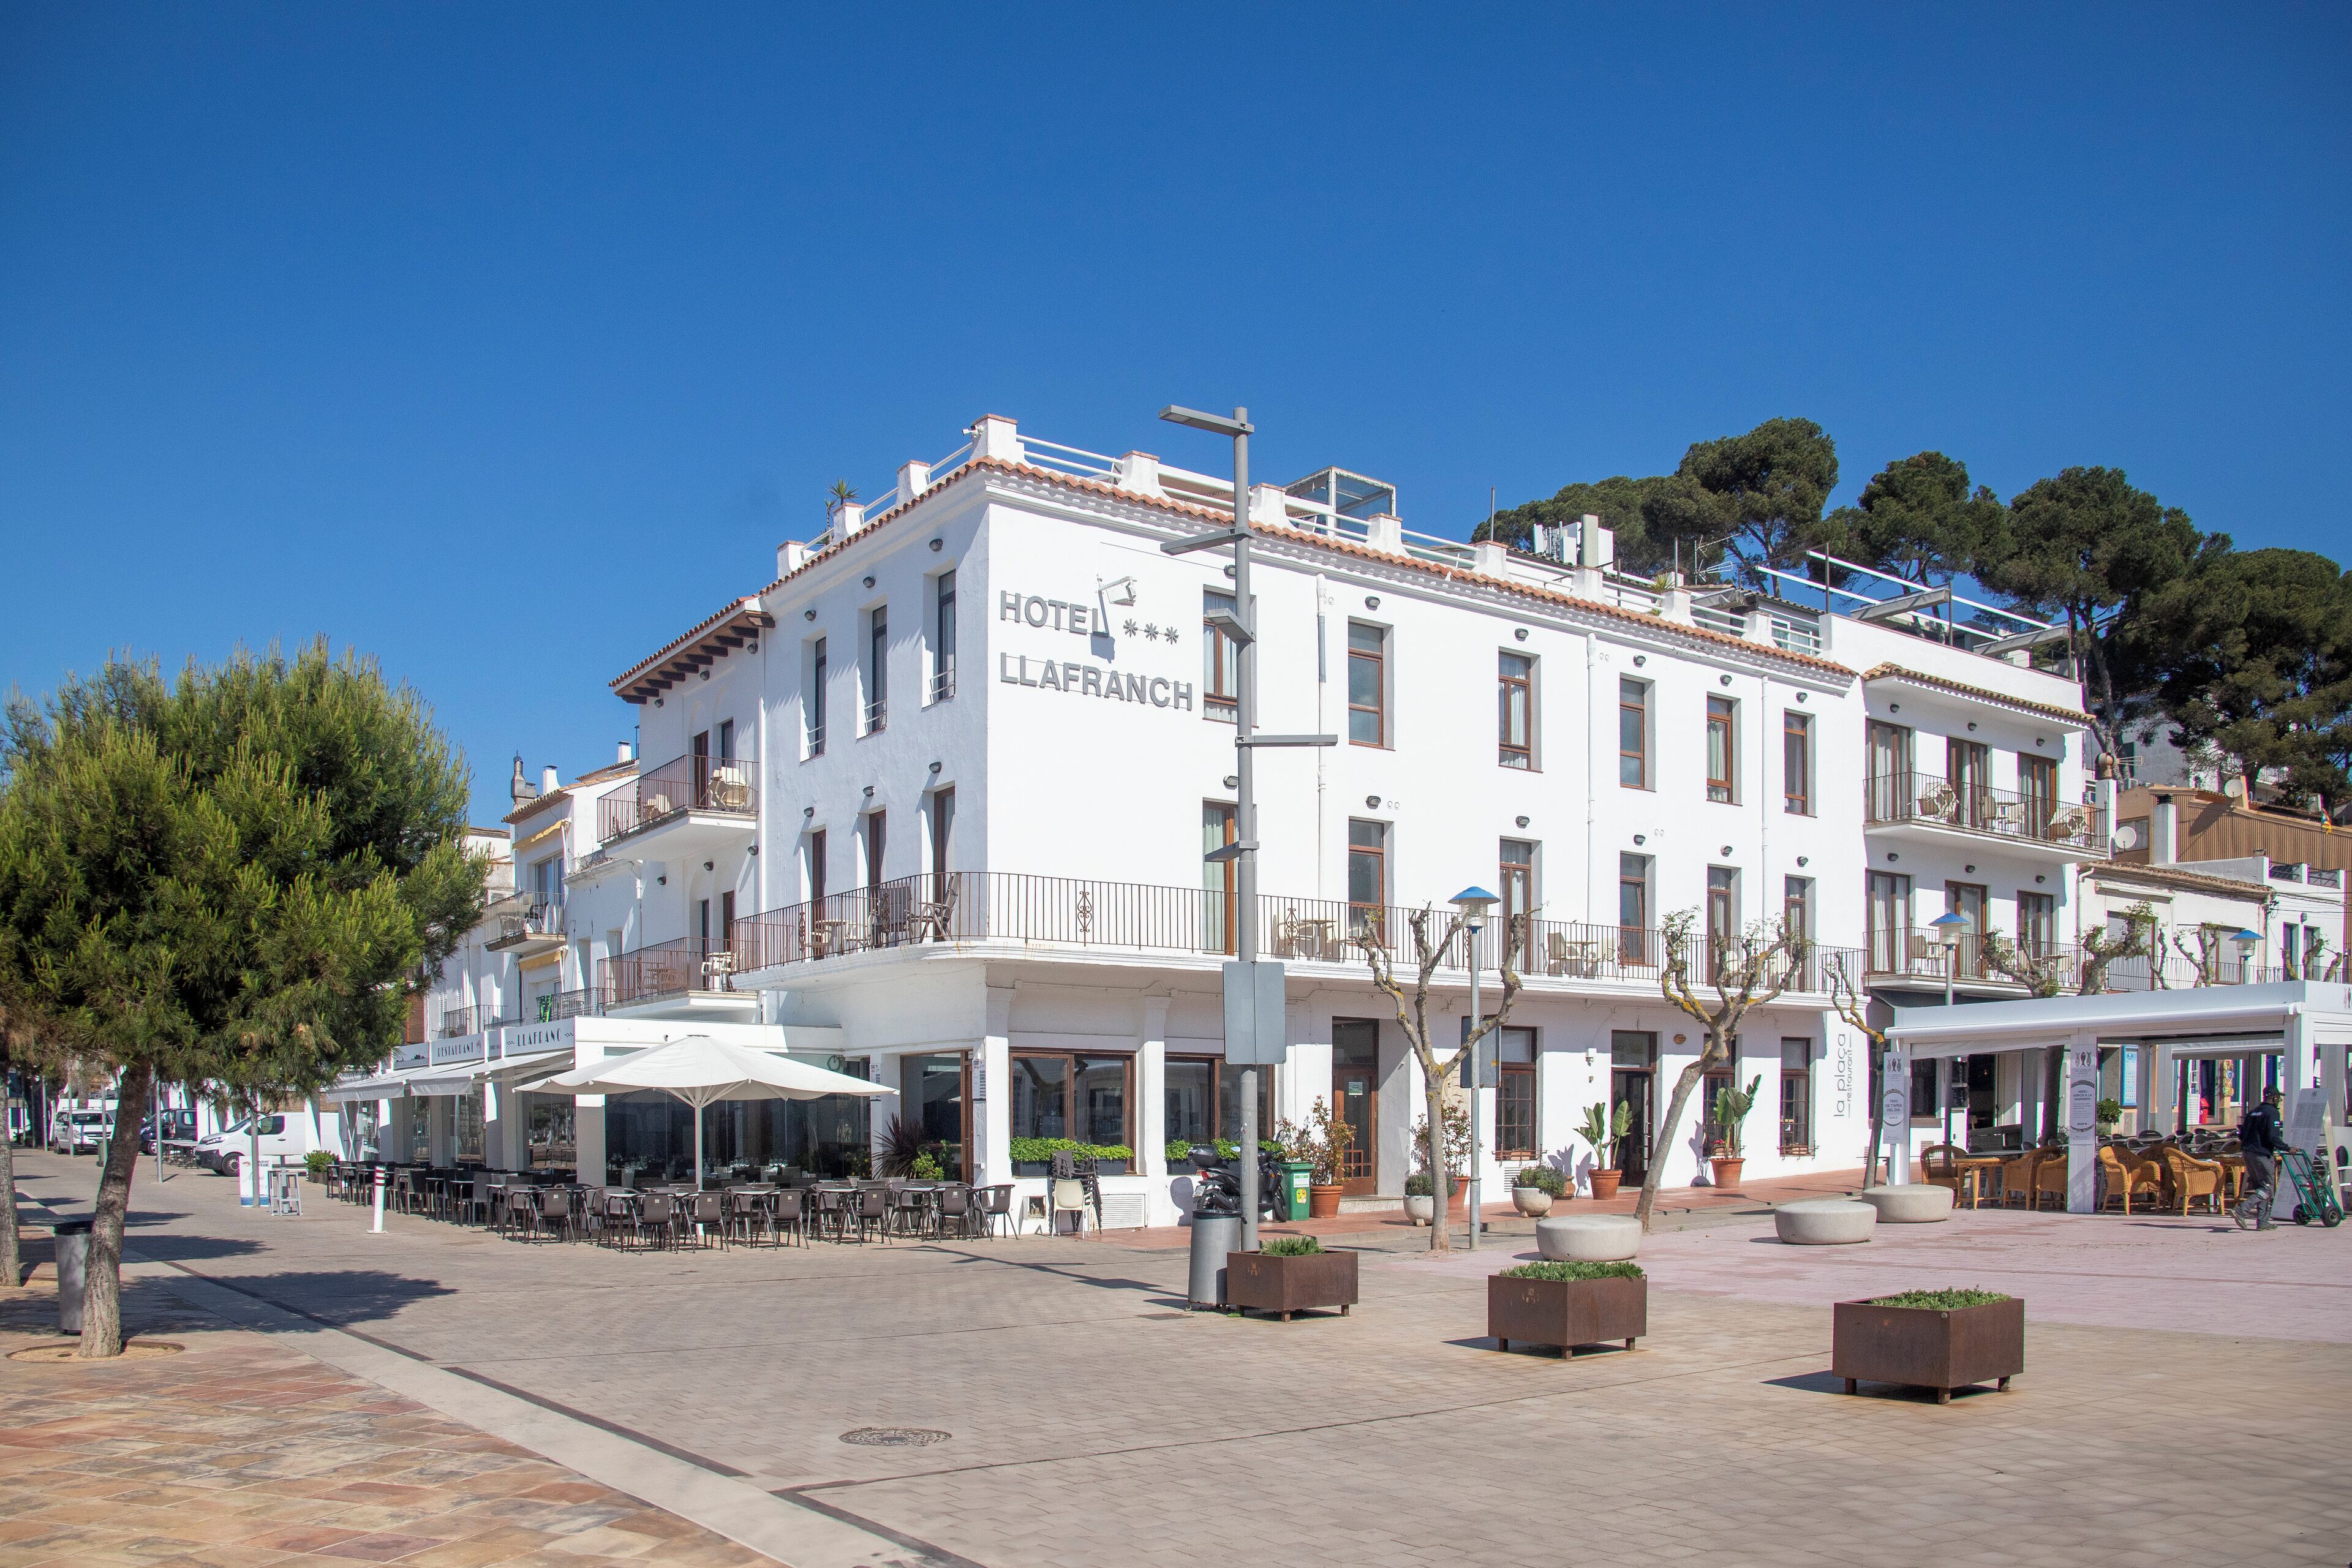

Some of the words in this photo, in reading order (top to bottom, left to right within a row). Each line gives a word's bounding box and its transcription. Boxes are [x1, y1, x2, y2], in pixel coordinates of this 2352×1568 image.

[1001, 590, 1107, 638] HOTEL
[1001, 652, 1193, 711] LLAFRANCH
[437, 1042, 475, 1058] RESTAURANT
[517, 1028, 562, 1047] LLAFRANC
[1834, 1034, 1848, 1091] plaça
[1833, 1100, 1845, 1117] la
